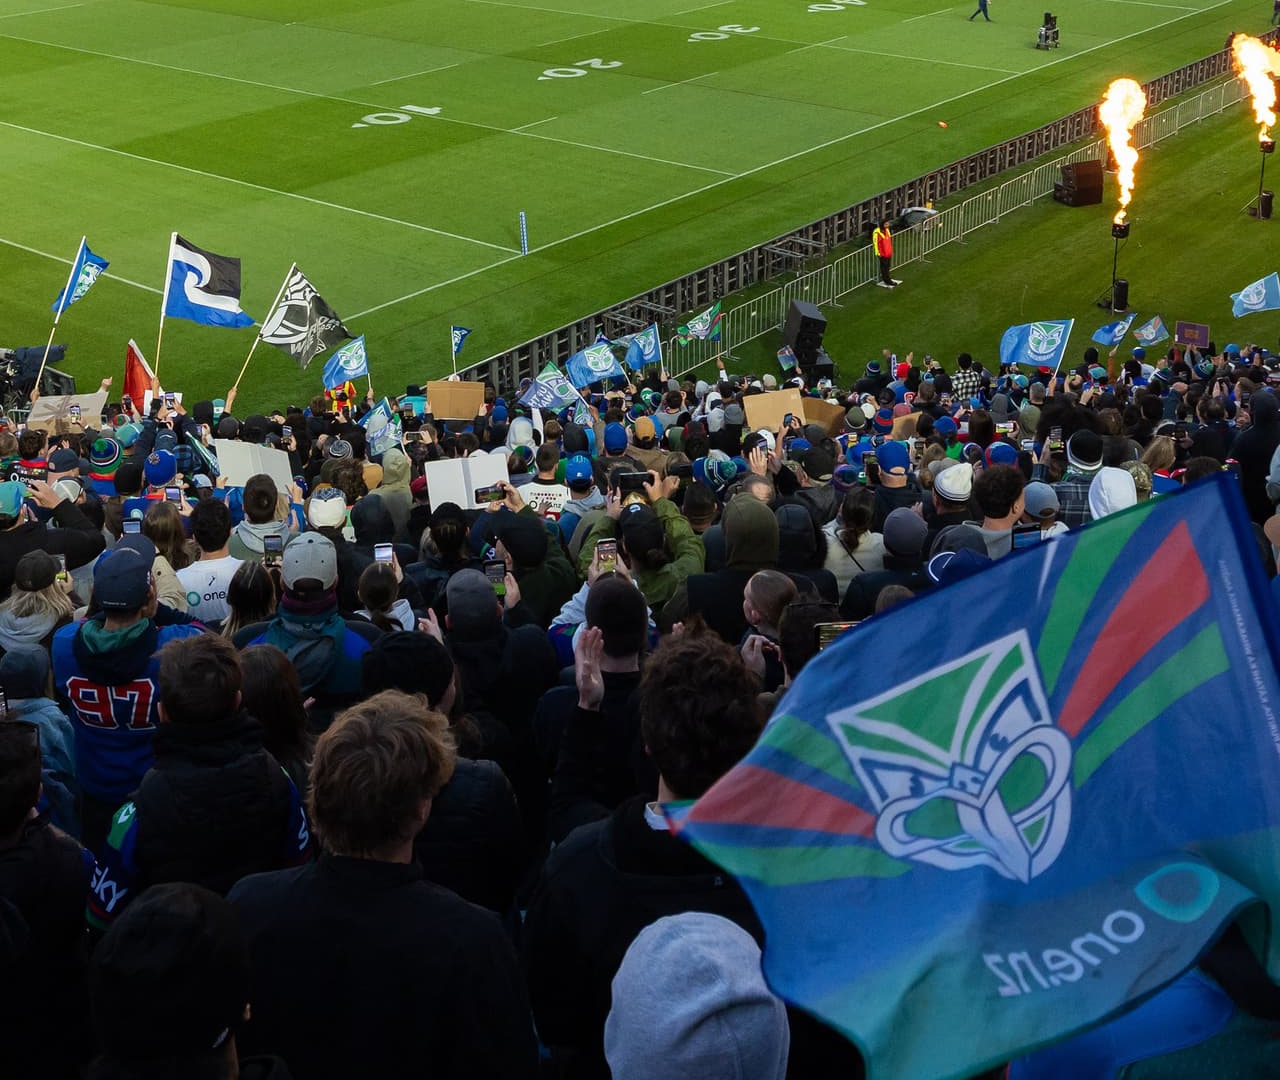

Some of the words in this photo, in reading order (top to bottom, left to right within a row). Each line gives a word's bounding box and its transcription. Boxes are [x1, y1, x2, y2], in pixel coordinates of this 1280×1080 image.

[690, 24, 761, 40] 30
[542, 58, 623, 79] 20
[361, 104, 442, 126] 10
[66, 676, 157, 731] 97
